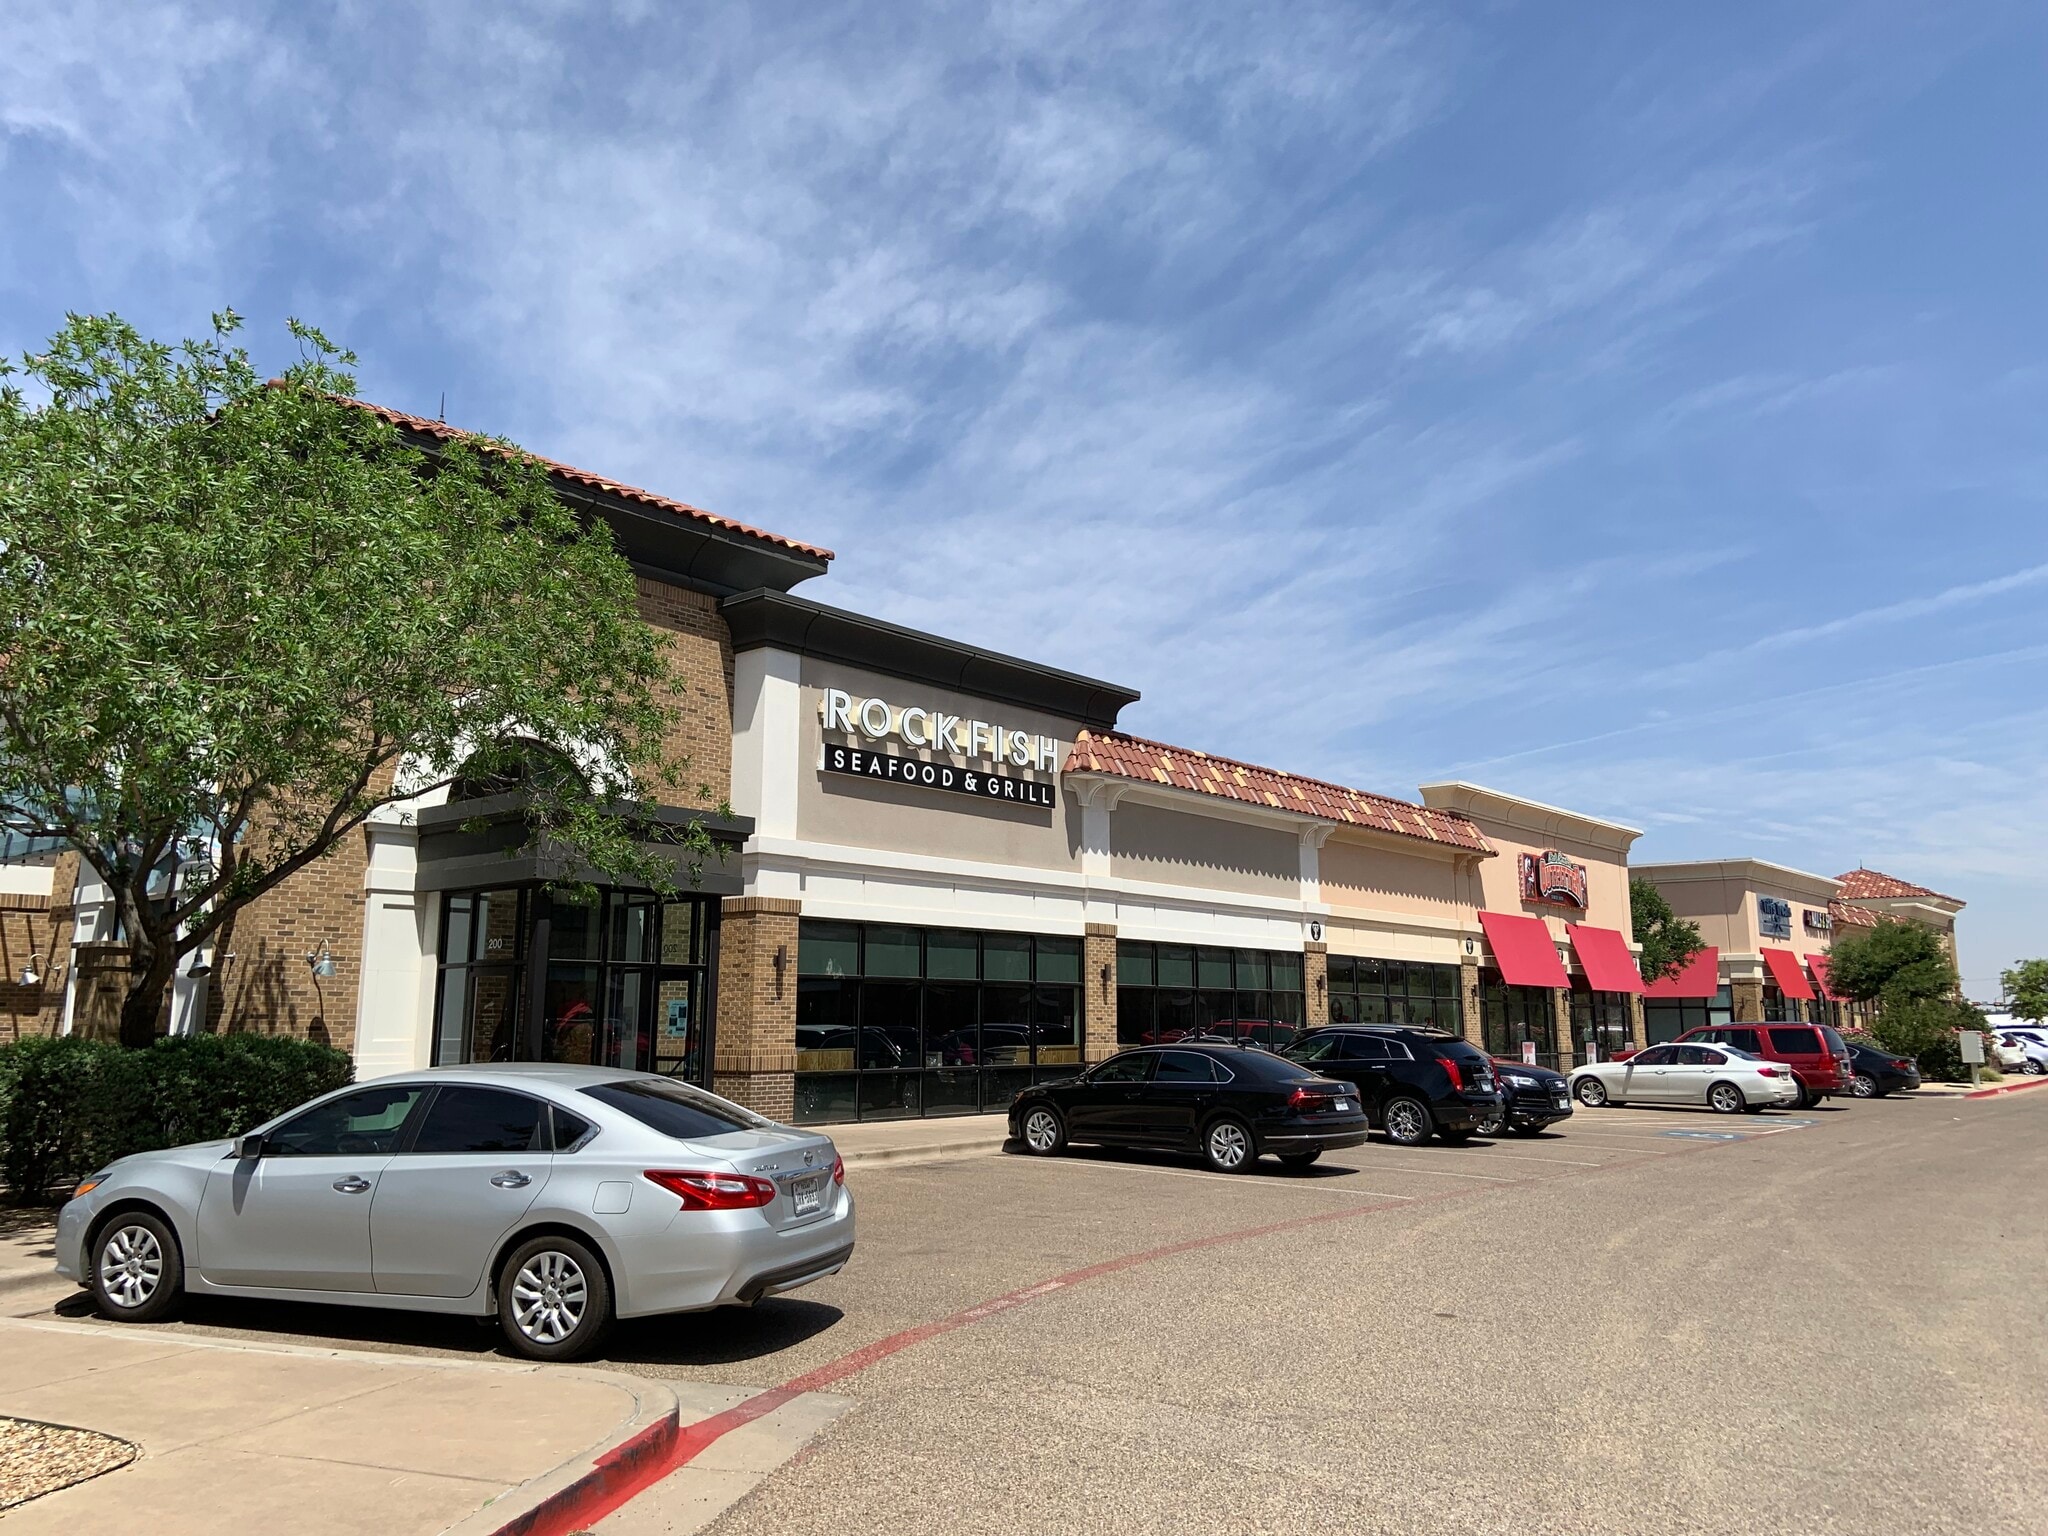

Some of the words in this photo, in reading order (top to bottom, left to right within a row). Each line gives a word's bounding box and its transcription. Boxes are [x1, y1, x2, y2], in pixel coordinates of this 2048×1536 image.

[823, 687, 1058, 773] ROCKFISH
[834, 750, 953, 787] SEAFOOD
[964, 772, 978, 792] &
[987, 777, 1050, 804] GRILL
[488, 938, 503, 949] 200
